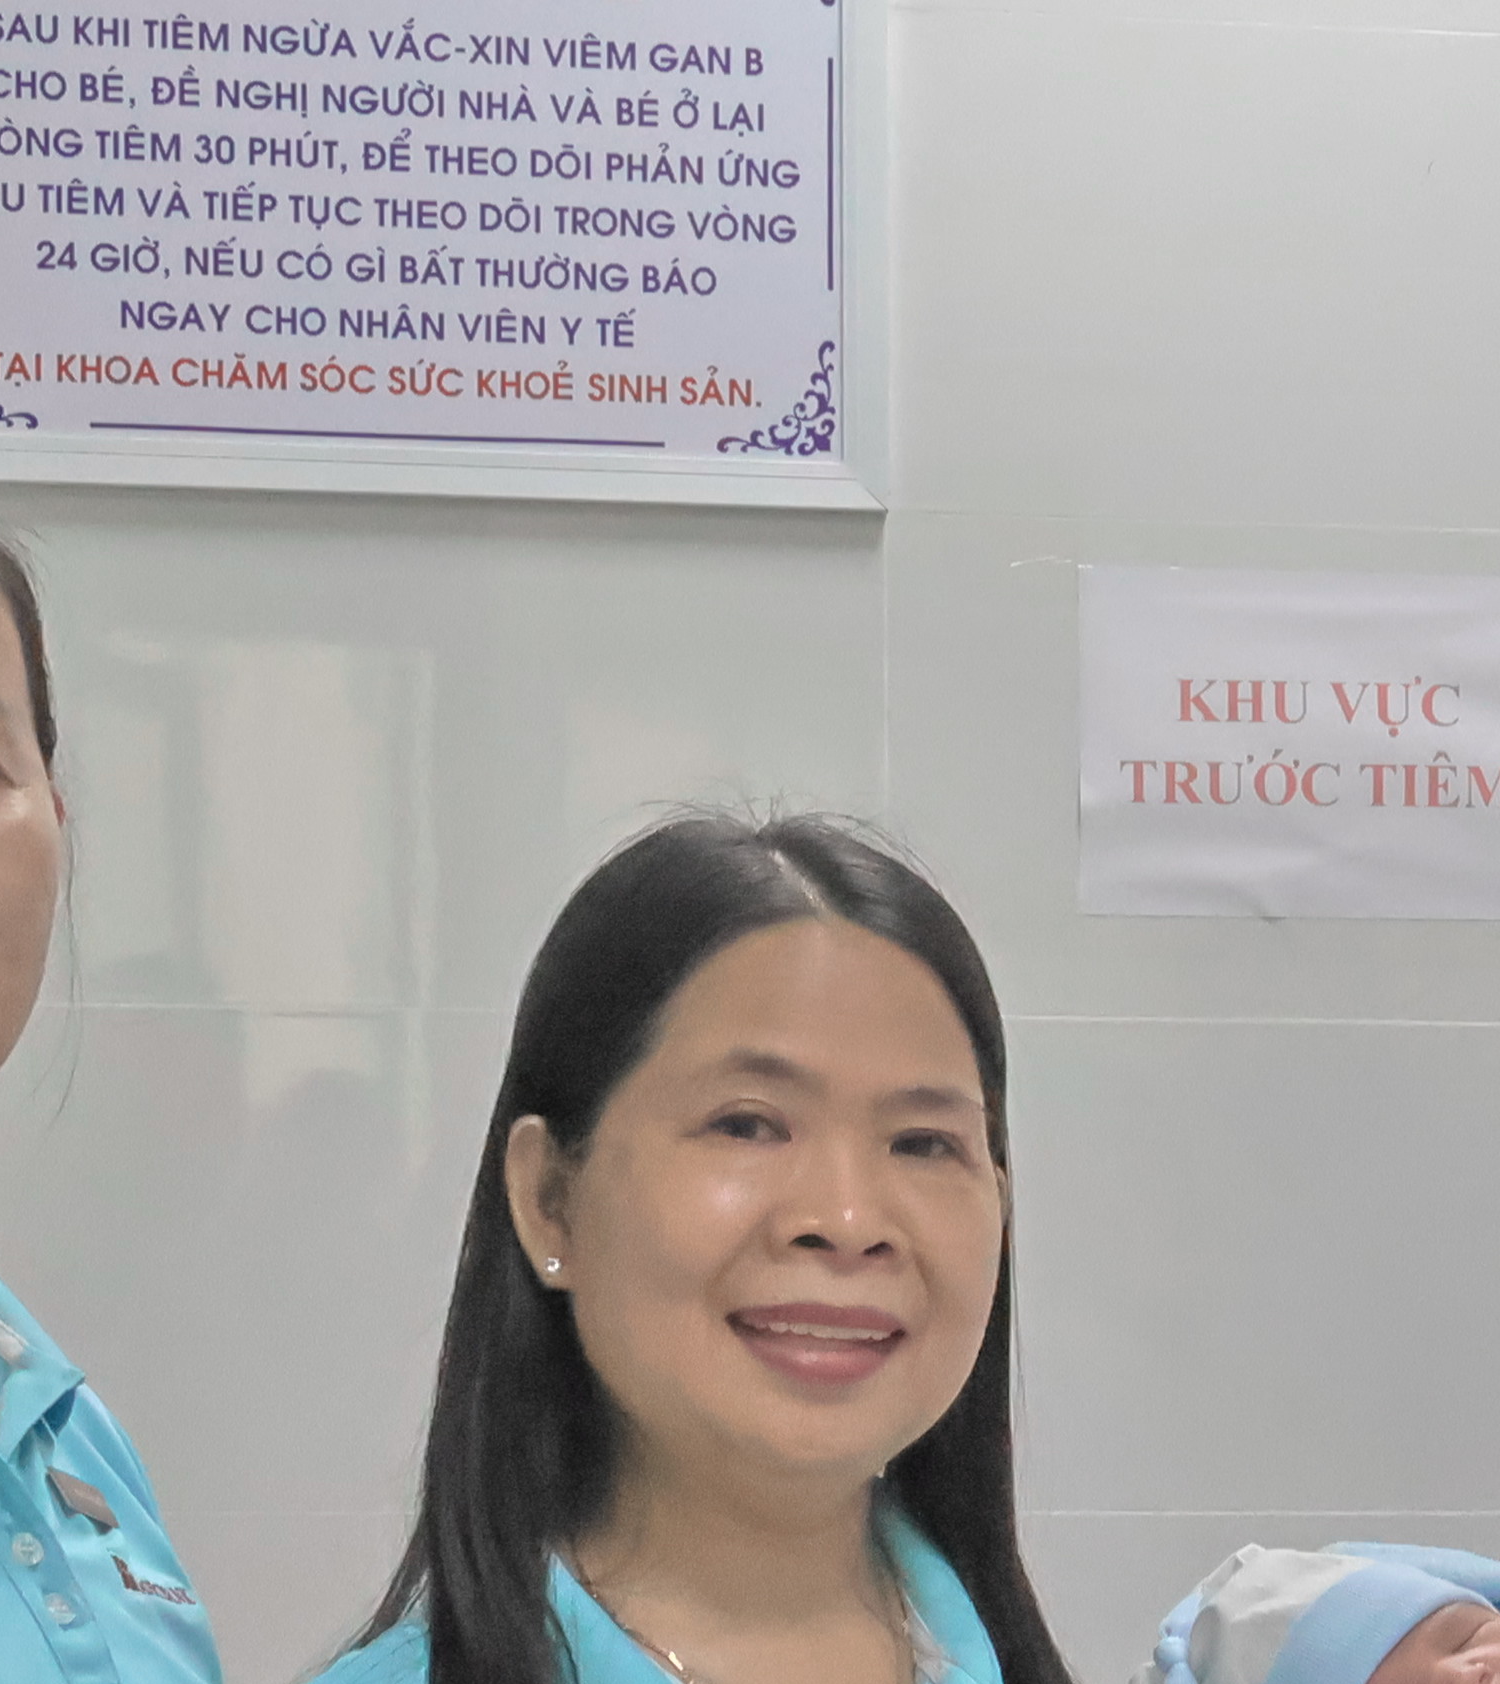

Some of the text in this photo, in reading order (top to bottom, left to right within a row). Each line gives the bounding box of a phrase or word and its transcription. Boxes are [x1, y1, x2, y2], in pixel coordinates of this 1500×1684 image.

[73, 17, 130, 48] KHI
[143, 14, 229, 52] TIÊM
[243, 19, 357, 58] NGỪA
[368, 17, 530, 66] VẮC-XIN
[543, 33, 637, 71] VIÊM
[649, 43, 731, 75] GAN
[745, 47, 764, 76] B
[79, 66, 136, 108] BÉ,
[151, 65, 200, 107] ĐỀ
[216, 79, 308, 118] NGHỊ
[322, 80, 445, 119] NGƯỜI
[459, 84, 537, 123] NHÀ
[550, 87, 602, 125] VÀ
[616, 90, 659, 128] BÉ
[672, 87, 700, 129] Ở
[712, 102, 765, 137] LẠI
[95, 125, 182, 162] TIÊM
[193, 134, 236, 165] 30
[248, 131, 349, 174] PHÚT,
[361, 127, 412, 172] ĐỂ
[424, 144, 518, 177] THEO
[605, 143, 704, 185] PHẢN
[718, 149, 800, 189] ỨNG
[38, 178, 125, 217] TIÊM
[137, 182, 190, 219] VÀ
[203, 181, 278, 221] TIẾP
[288, 194, 362, 230] TỤC
[374, 199, 467, 230] THEO
[554, 205, 676, 239] TRONG
[687, 205, 798, 244] VÒNG
[36, 236, 717, 296] 24 GIỜ, NẾU CÓ GÌ BẤT THƯỜNG BÁO
[120, 300, 637, 348] NGAY CHO NHÂN VIÊN Y TẾ
[56, 355, 160, 387] KHOA
[171, 352, 287, 391] CHĂM
[300, 355, 376, 394] SÓC
[387, 359, 465, 397] SỨC
[477, 359, 574, 401] KHOẺ
[587, 372, 668, 404] SINH
[679, 365, 763, 408] SẢN.
[1177, 675, 1461, 738] KHU VỰC
[1119, 748, 1341, 806] TRƯỚC
